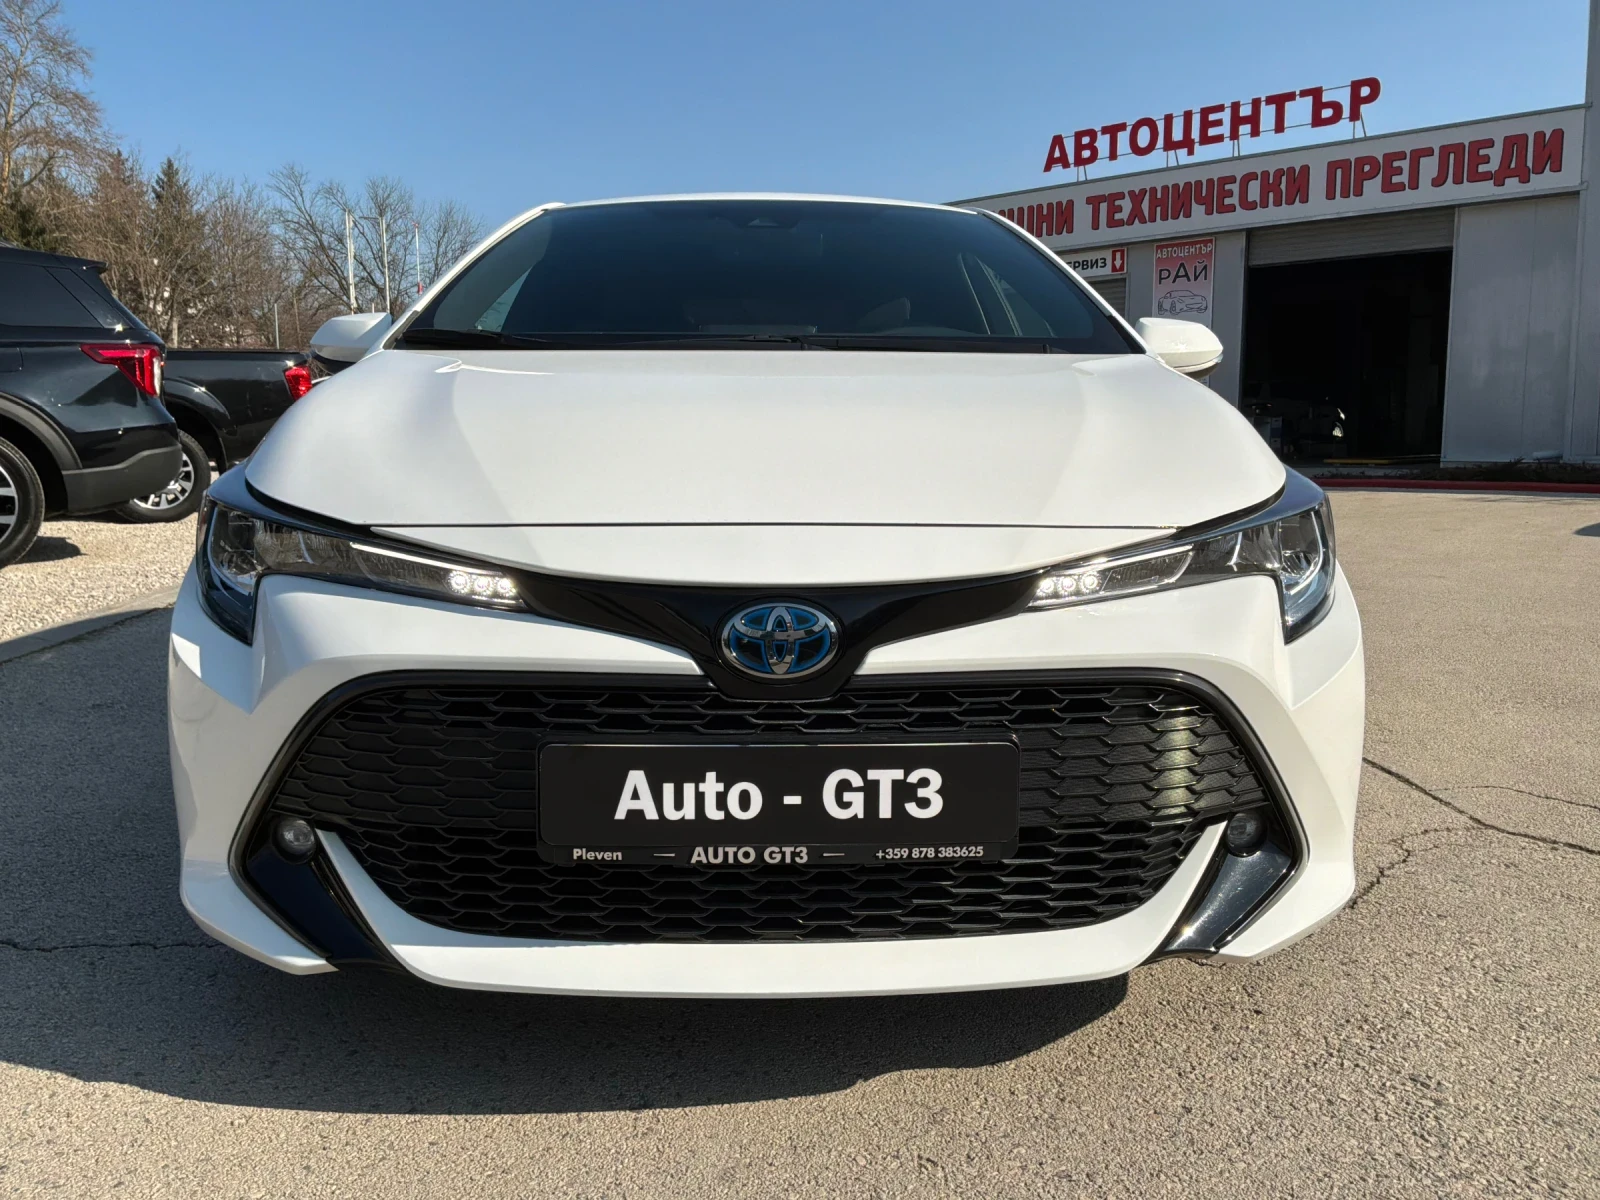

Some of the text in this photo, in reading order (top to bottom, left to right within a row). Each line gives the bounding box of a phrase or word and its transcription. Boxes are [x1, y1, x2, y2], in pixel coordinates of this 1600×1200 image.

[1043, 77, 1381, 172] АВТОЦЕНТЪР
[1086, 164, 1310, 230] ТЕХНИЧЕСКИ
[1326, 128, 1565, 200] ПРЕГЛЕДИ
[1157, 243, 1213, 259] АВТОЦЕНТЪР
[1158, 260, 1208, 285] РАЙ
[614, 769, 763, 821] Auto
[822, 768, 944, 820] GT3
[572, 848, 623, 861] Pleven
[690, 846, 808, 864] AUTO GT3
[875, 846, 984, 860] +359 878 383625
